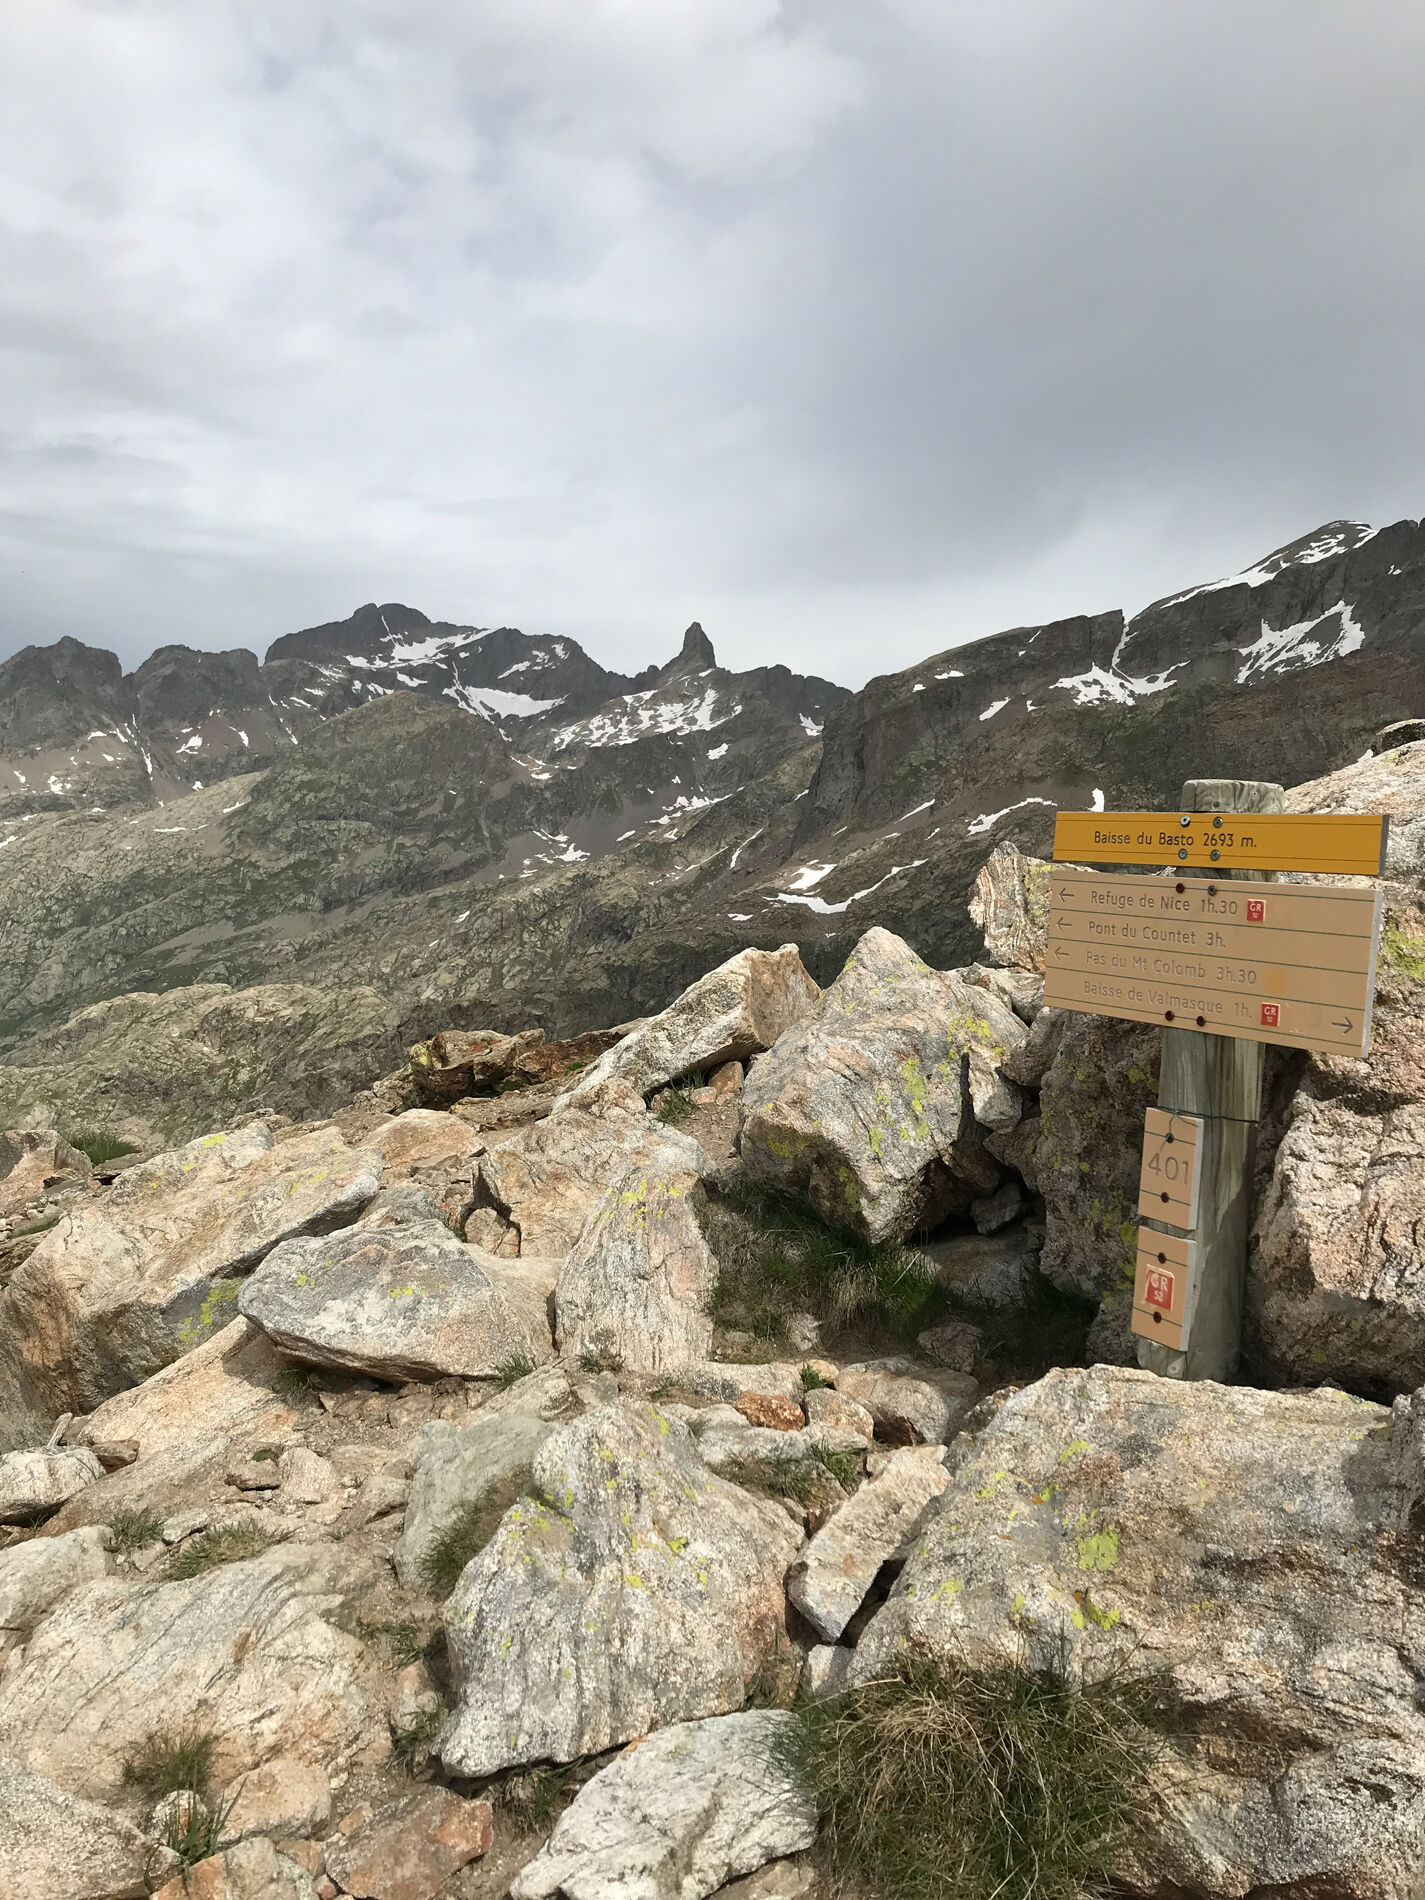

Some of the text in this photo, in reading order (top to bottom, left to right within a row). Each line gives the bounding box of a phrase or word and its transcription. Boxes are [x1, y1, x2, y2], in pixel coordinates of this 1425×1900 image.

[1093, 831, 1257, 848] Baisse du Basto 2693 m.
[1091, 891, 1238, 915] Refuge de Nice 1h.30
[1250, 903, 1262, 911] GR
[1089, 921, 1226, 948] Pont du Countet 3h.
[1086, 951, 1256, 985] Pas du Mt Colomb 3h.30
[1084, 981, 1251, 1018] Baisse de Valmasque 1h.
[1264, 1007, 1276, 1016] GR
[1147, 1152, 1189, 1185] 401
[1150, 1273, 1168, 1292] GR
